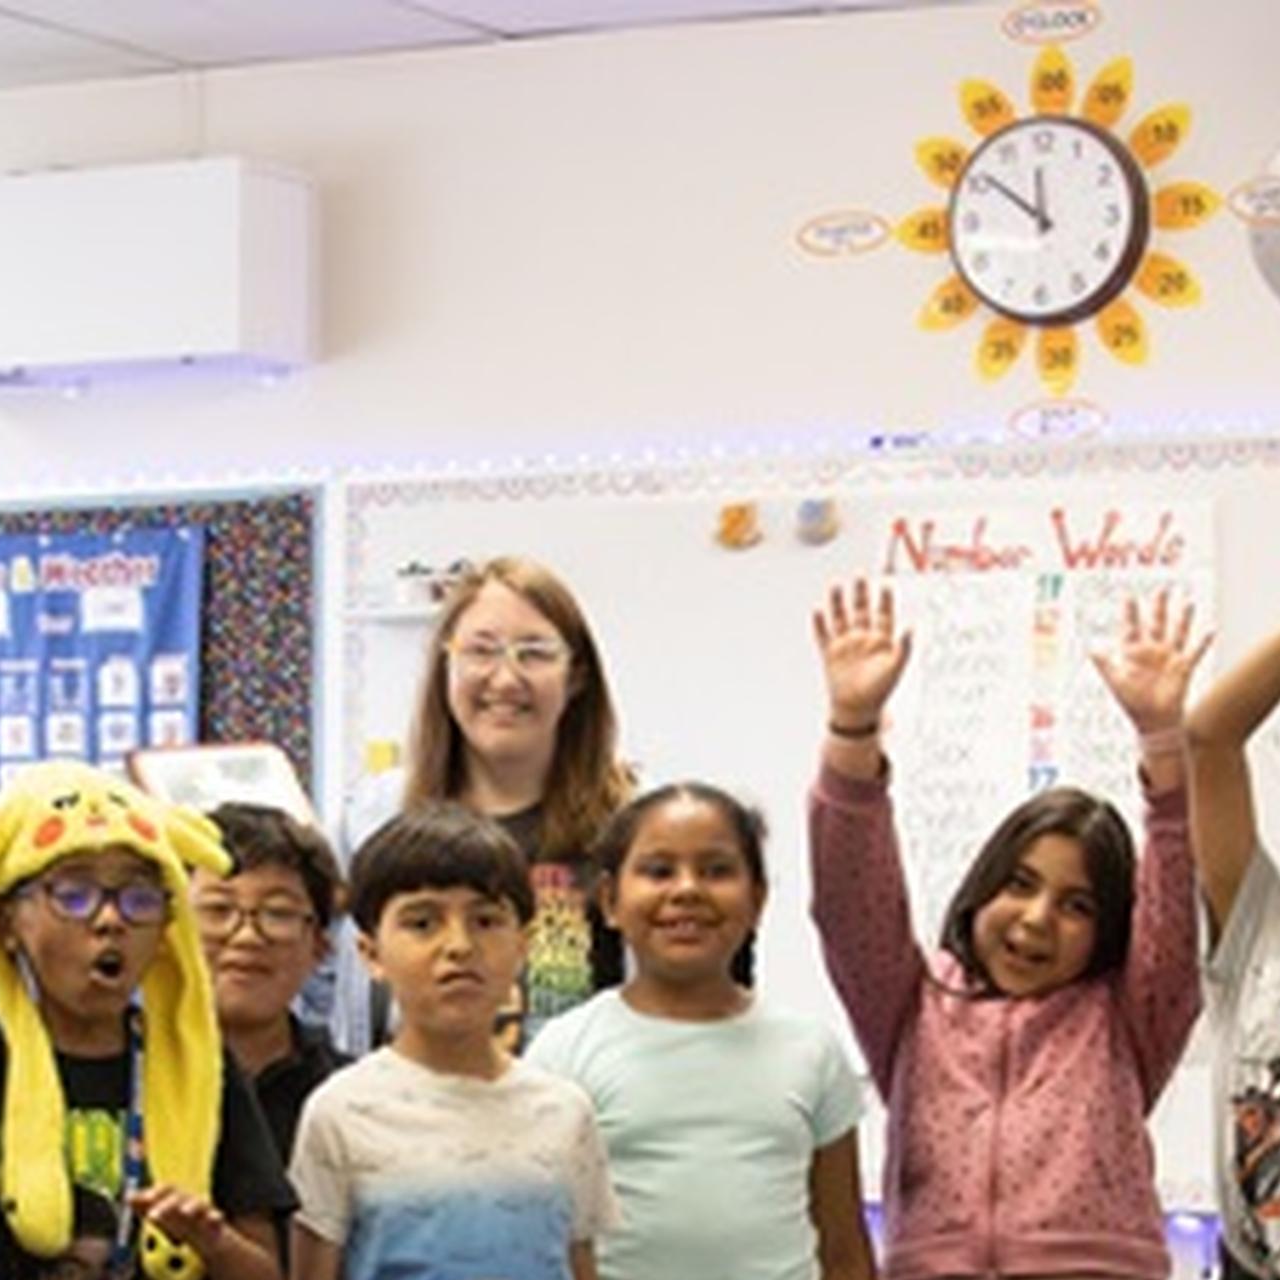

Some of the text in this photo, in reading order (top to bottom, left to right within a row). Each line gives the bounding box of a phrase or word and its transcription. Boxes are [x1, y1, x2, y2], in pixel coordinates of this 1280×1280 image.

[1096, 162, 1113, 188] 2
[1104, 203, 1121, 228] 3
[884, 508, 1184, 574] Number Words
[39, 553, 159, 592] Weather
